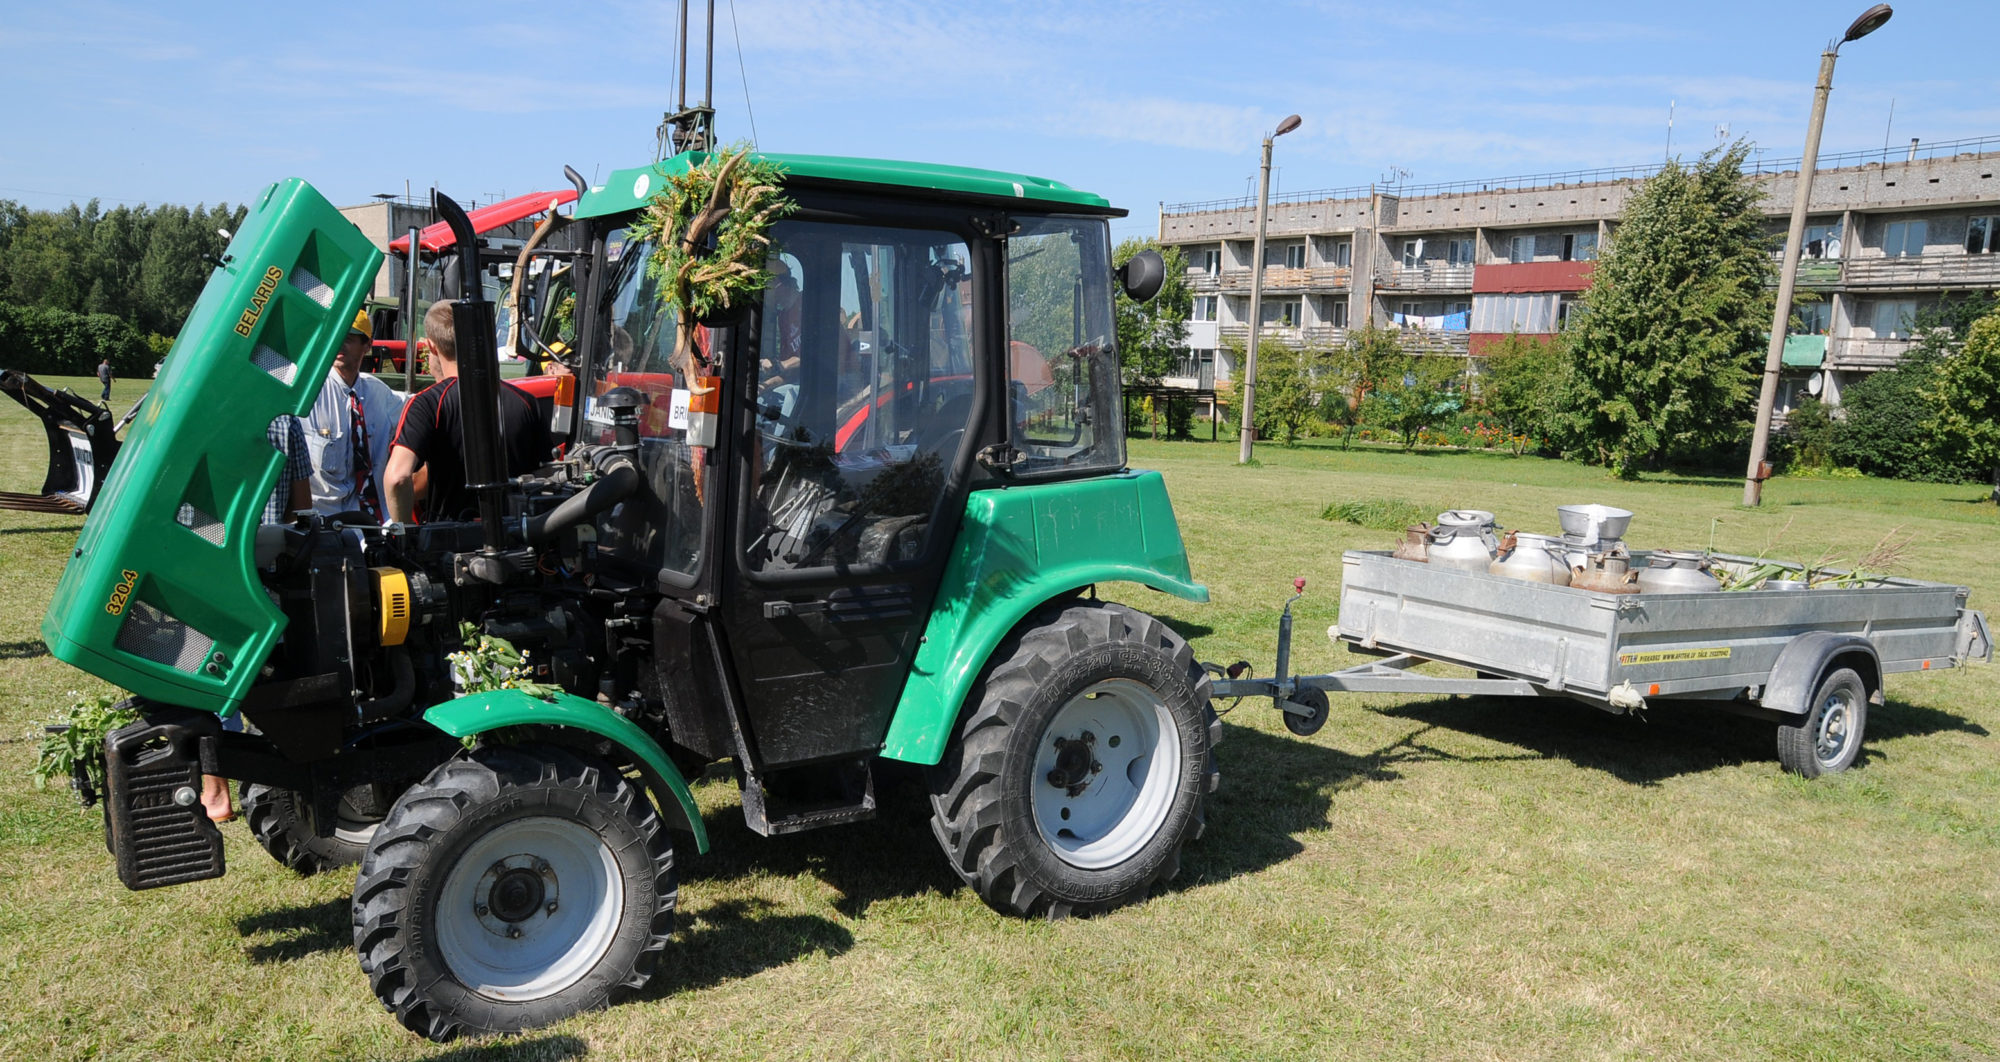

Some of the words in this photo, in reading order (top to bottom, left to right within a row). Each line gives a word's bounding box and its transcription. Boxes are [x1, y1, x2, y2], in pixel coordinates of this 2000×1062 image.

[234, 265, 283, 338] BELARUS
[105, 569, 138, 615] 320.4
[632, 867, 653, 941] ROSAVA
